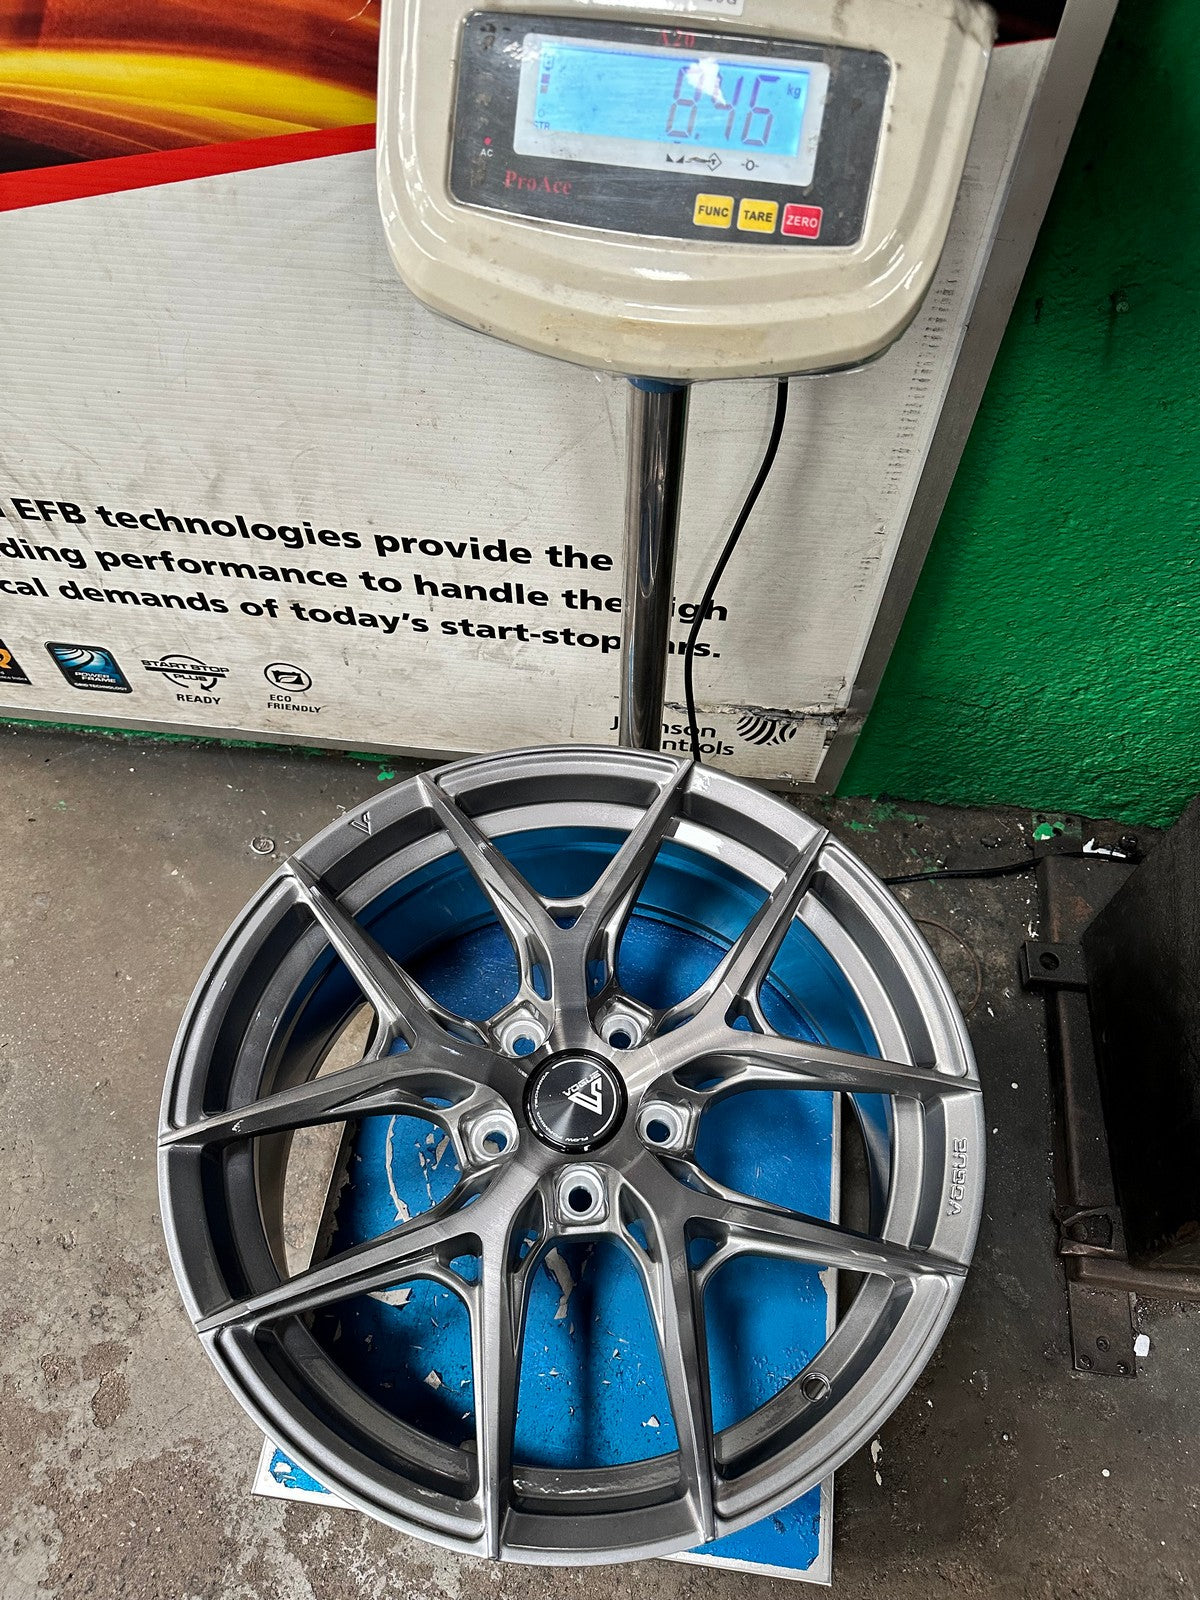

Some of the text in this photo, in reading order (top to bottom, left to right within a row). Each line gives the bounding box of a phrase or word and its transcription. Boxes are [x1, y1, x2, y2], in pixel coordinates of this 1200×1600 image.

[787, 84, 801, 100] kg
[480, 148, 493, 158] AC
[504, 169, 573, 196] ProAce
[698, 205, 729, 218] FUNC
[743, 210, 773, 223] TARE
[786, 213, 818, 229] ZERO
[10, 498, 614, 572] EFB technologies provide the
[94, 549, 347, 587] performance
[359, 571, 402, 593] to
[413, 574, 549, 606] handle
[561, 588, 621, 613] the
[59, 580, 229, 614] demands
[240, 598, 279, 618] of
[290, 602, 429, 634] today's
[440, 618, 621, 654] start-stop
[141, 660, 230, 672] START STOP
[74, 671, 110, 679] POWER
[81, 676, 116, 684] FRAME
[173, 673, 208, 682] PLUS
[176, 693, 221, 705] READY
[269, 694, 292, 703] ECO
[267, 702, 321, 714] FRIENDLY
[562, 1070, 601, 1096] VOGUE
[946, 1137, 968, 1217] VOGUE
